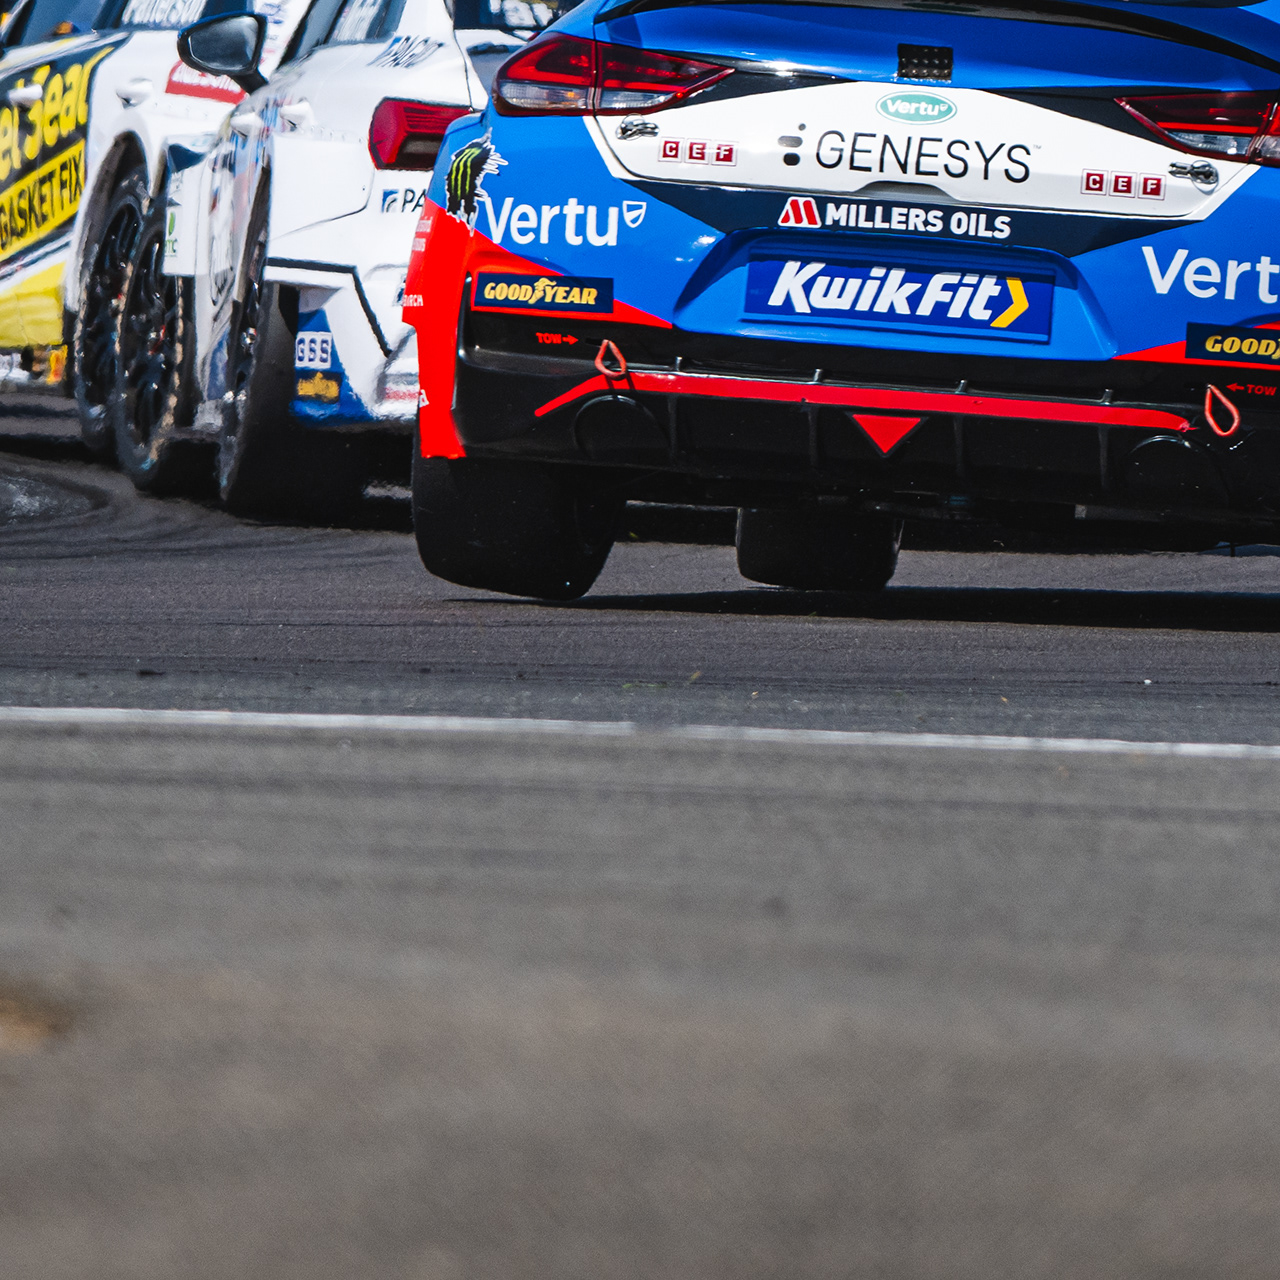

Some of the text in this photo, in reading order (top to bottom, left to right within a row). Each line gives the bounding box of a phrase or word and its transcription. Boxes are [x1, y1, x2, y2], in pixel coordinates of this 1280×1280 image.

[886, 99, 939, 116] Vertu
[815, 129, 1031, 183] GENESYS
[484, 197, 619, 247] Vertu
[825, 202, 1012, 239] MILLERS OILS
[536, 332, 563, 345] TOW
[1246, 384, 1278, 396] TOW
